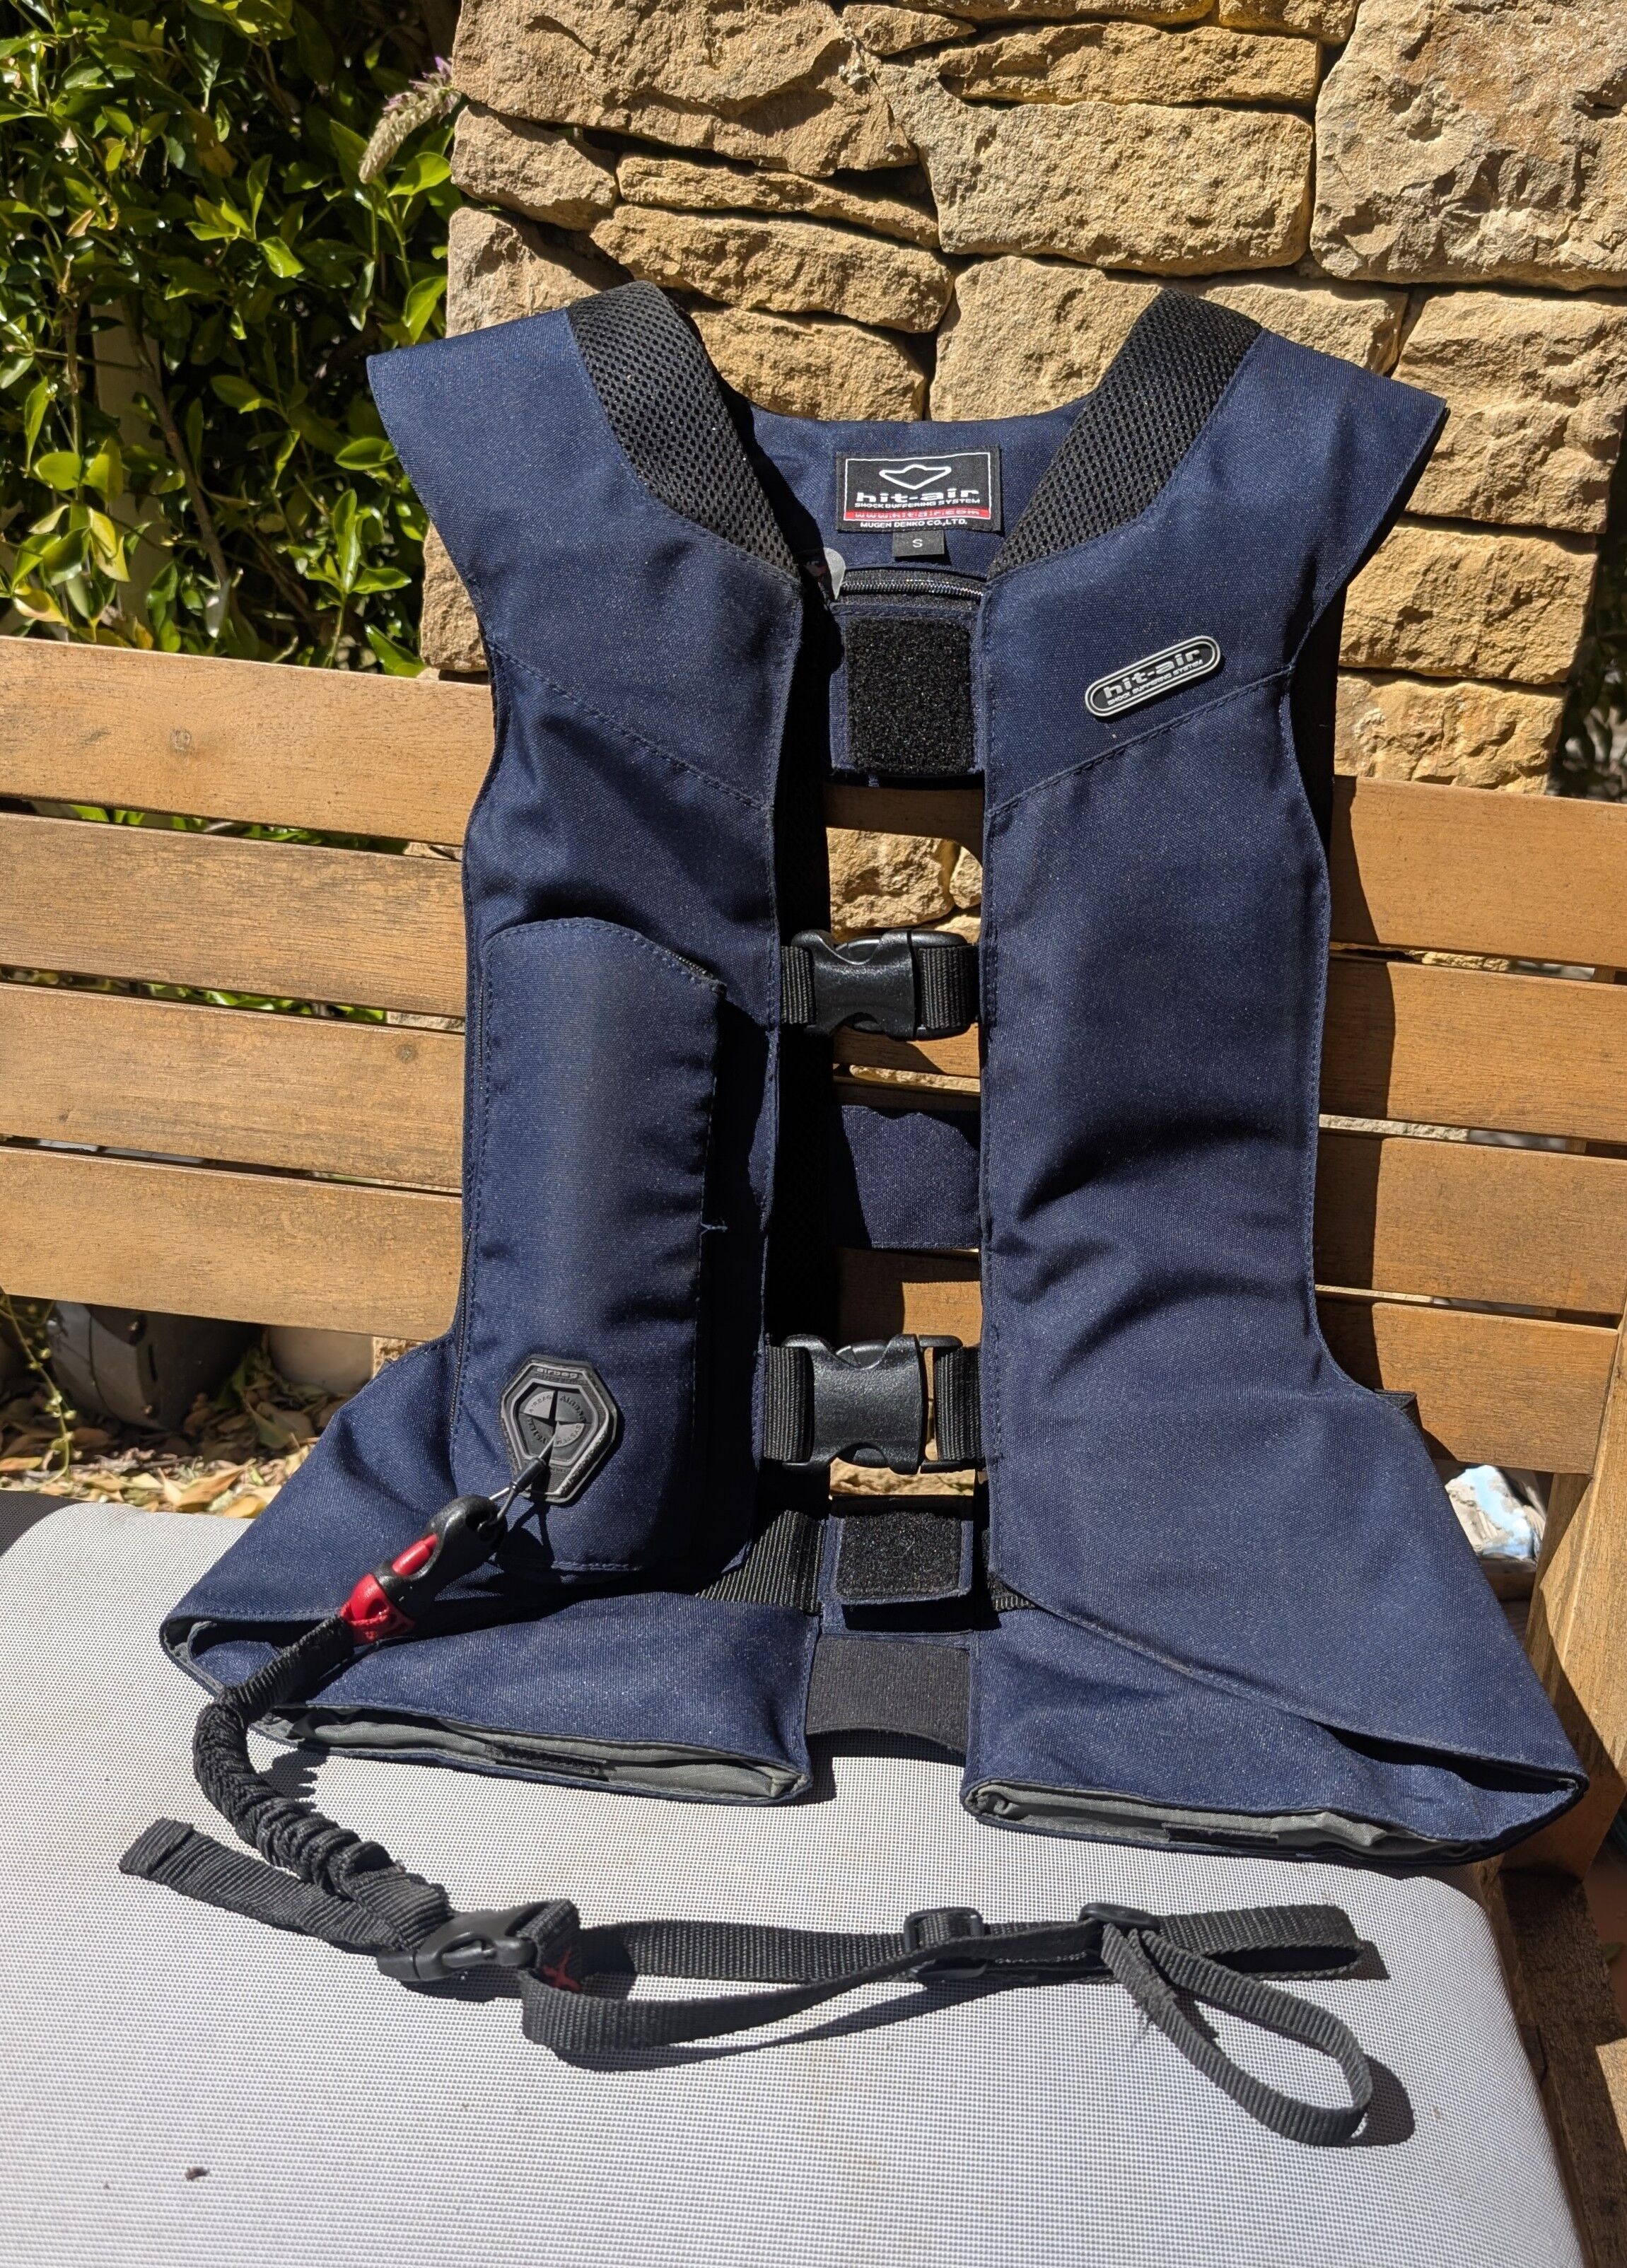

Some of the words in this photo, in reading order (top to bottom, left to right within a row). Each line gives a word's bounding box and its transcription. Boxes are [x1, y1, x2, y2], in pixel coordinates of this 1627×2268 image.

[856, 488, 979, 503] hit-air
[912, 539, 923, 548] S
[1103, 649, 1200, 698] hit-air
[1107, 690, 1131, 706] SHOCK
[1174, 659, 1203, 676] SYSTEM
